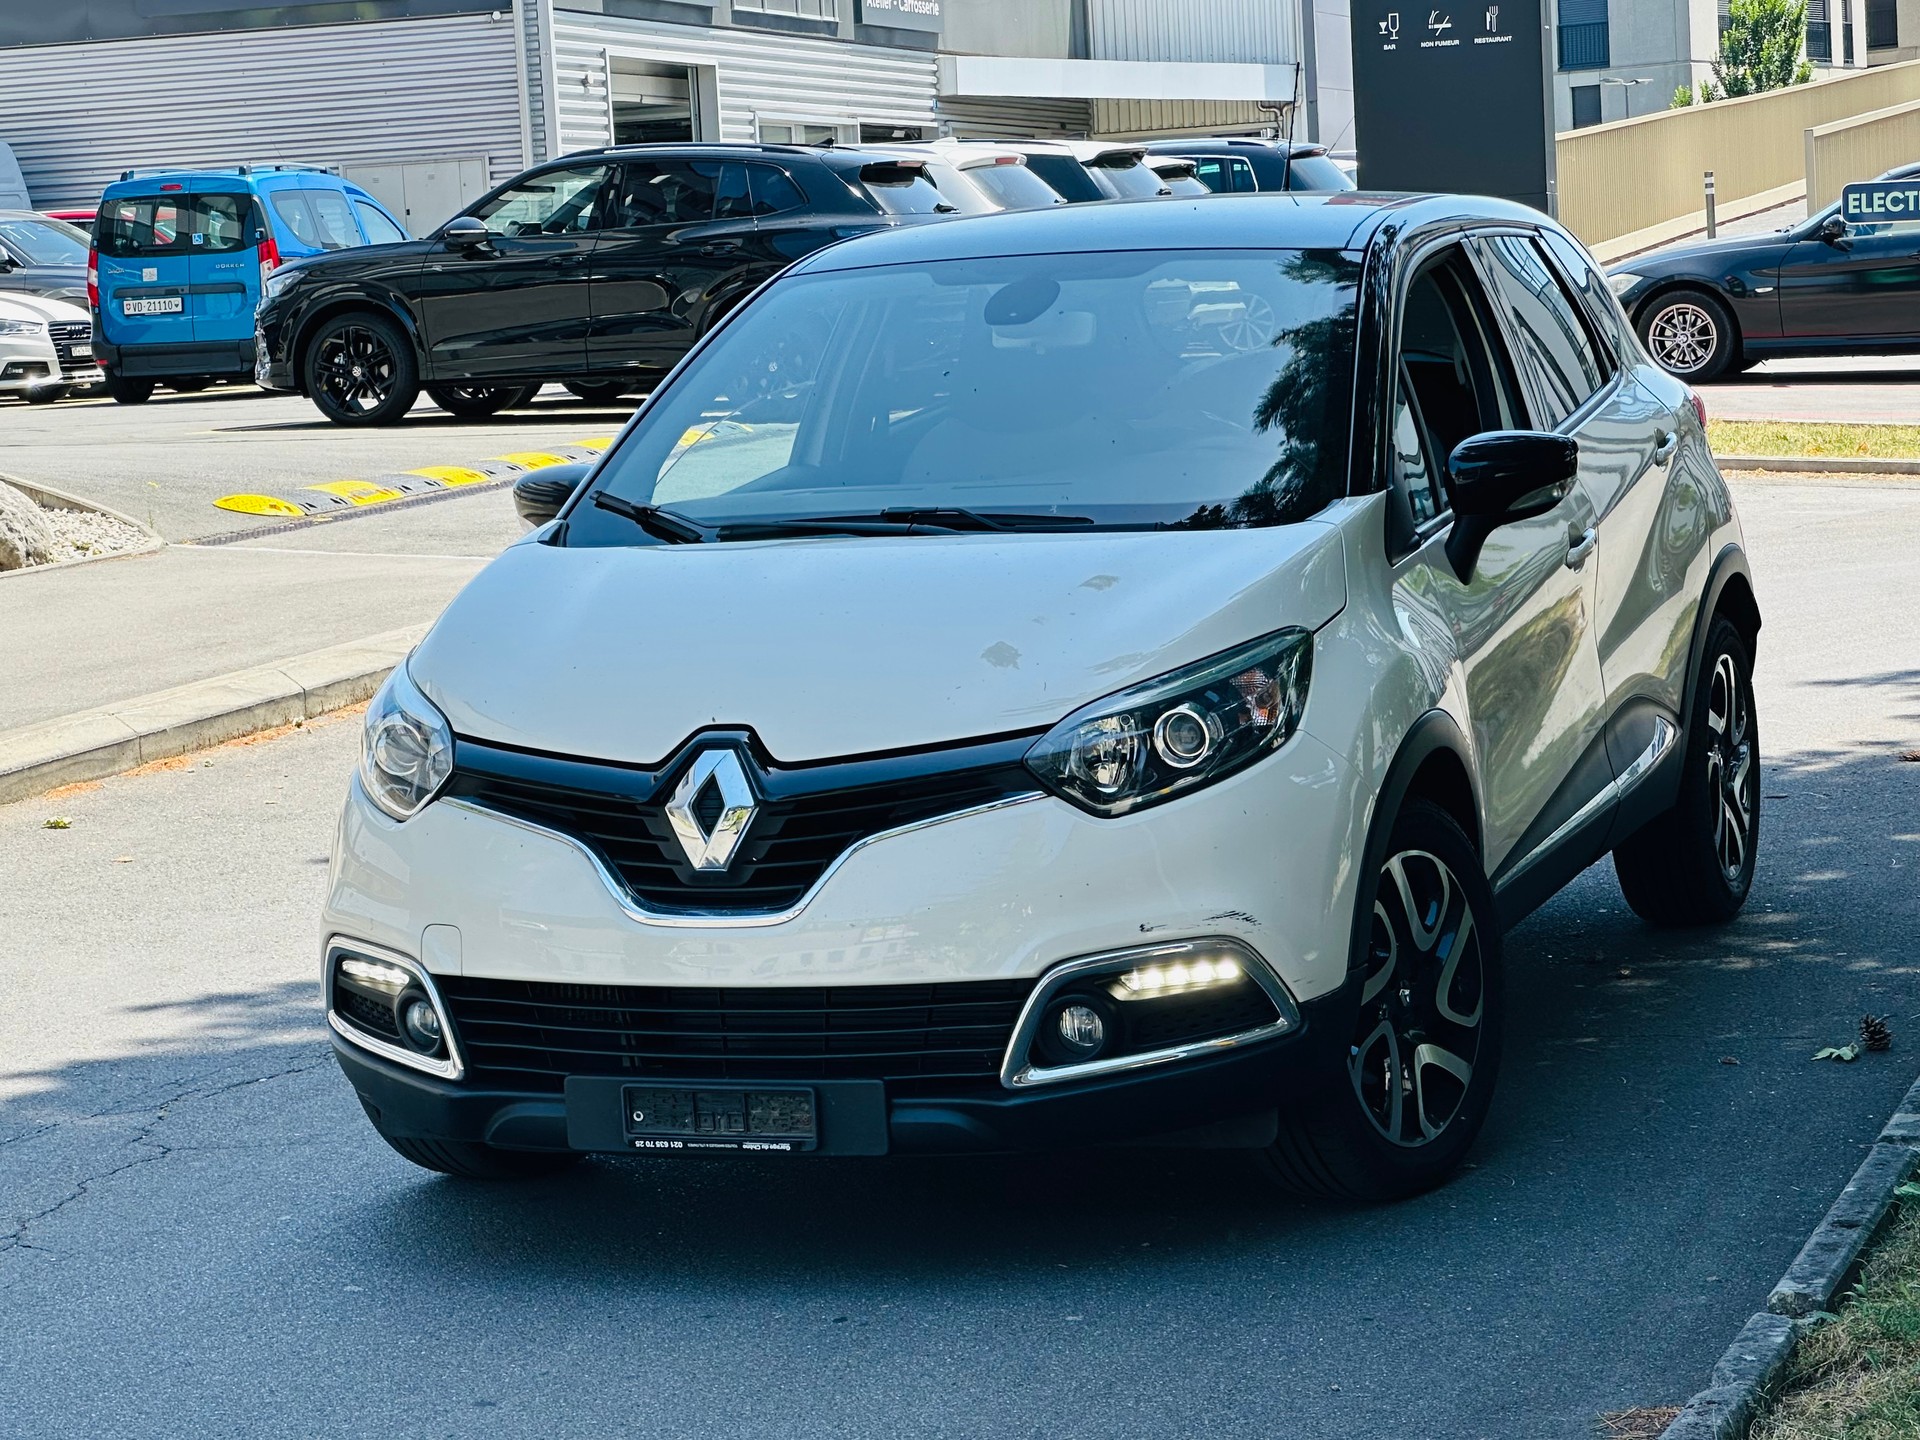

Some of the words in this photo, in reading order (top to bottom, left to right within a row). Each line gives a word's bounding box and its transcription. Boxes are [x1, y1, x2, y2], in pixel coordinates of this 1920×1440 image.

[899, 0, 939, 16] Carrosserie
[1435, 39, 1460, 47] FUMEUR
[1474, 35, 1513, 44] RESTAURANT
[1848, 191, 1920, 214] ELECT
